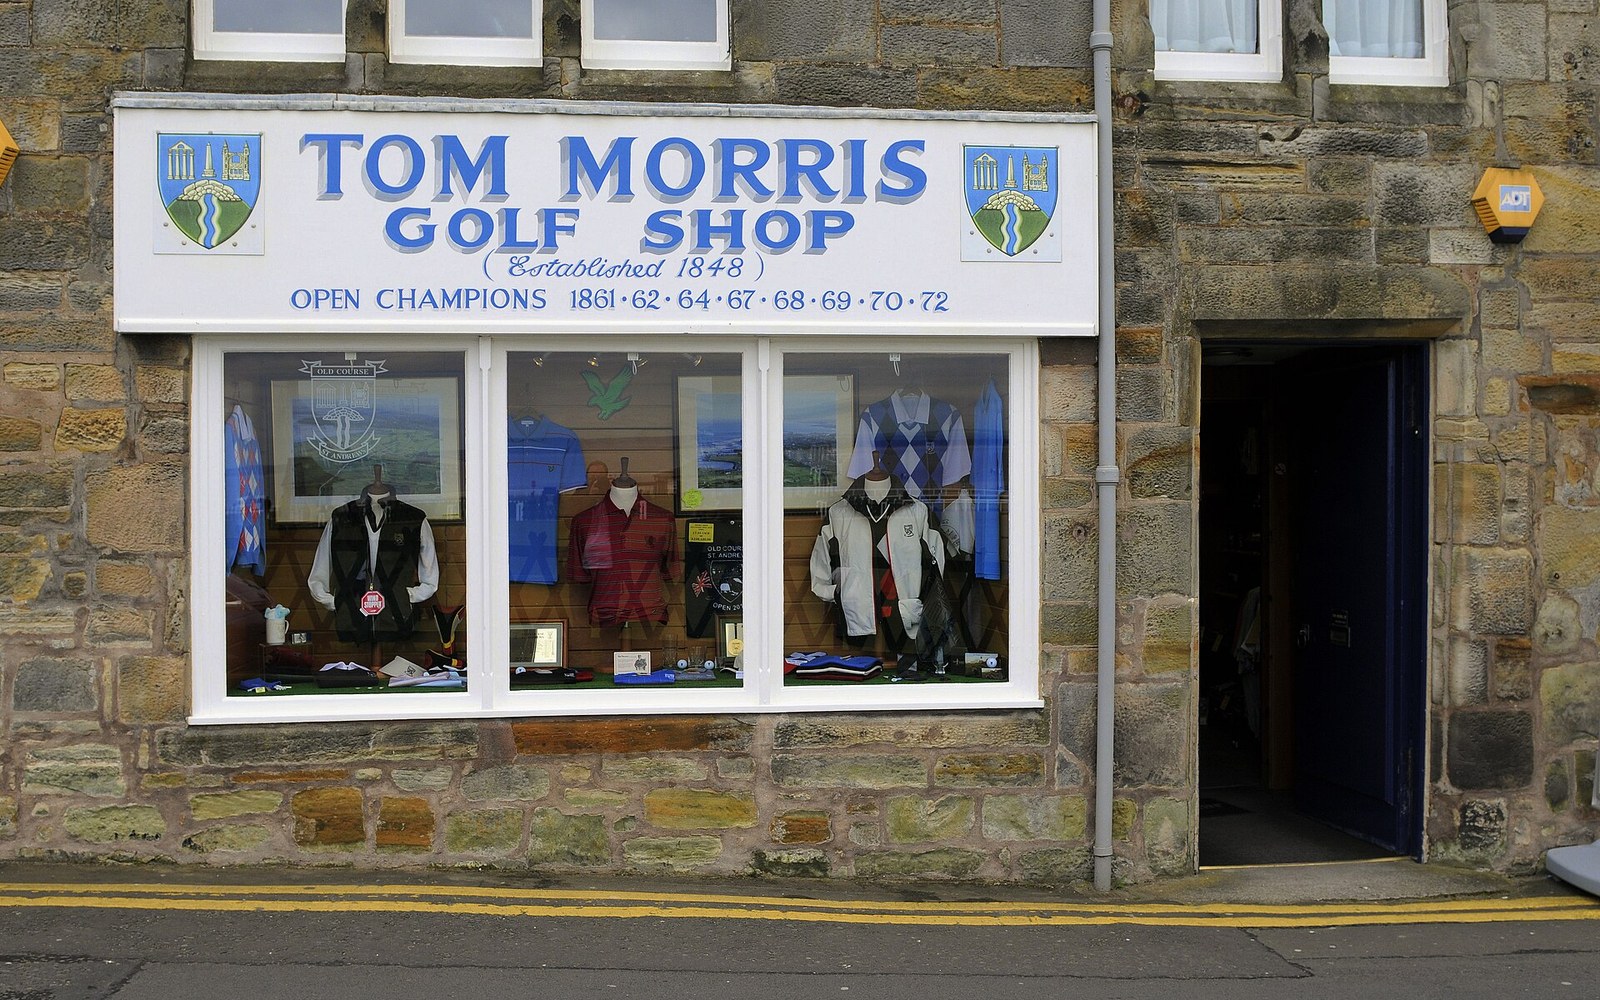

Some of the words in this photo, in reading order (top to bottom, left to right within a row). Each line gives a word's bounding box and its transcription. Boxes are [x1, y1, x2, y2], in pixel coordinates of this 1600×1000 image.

[300, 133, 509, 203] TOM
[557, 136, 928, 204] MORRIS
[1501, 191, 1531, 206] ADT
[384, 207, 580, 254] GOLF
[639, 208, 855, 255] SHOP
[290, 288, 360, 311] OPEN
[375, 287, 547, 312] CHAMPIONS
[322, 448, 330, 457] ST
[331, 448, 367, 459] ANDREWS
[712, 602, 731, 611] OPEN
